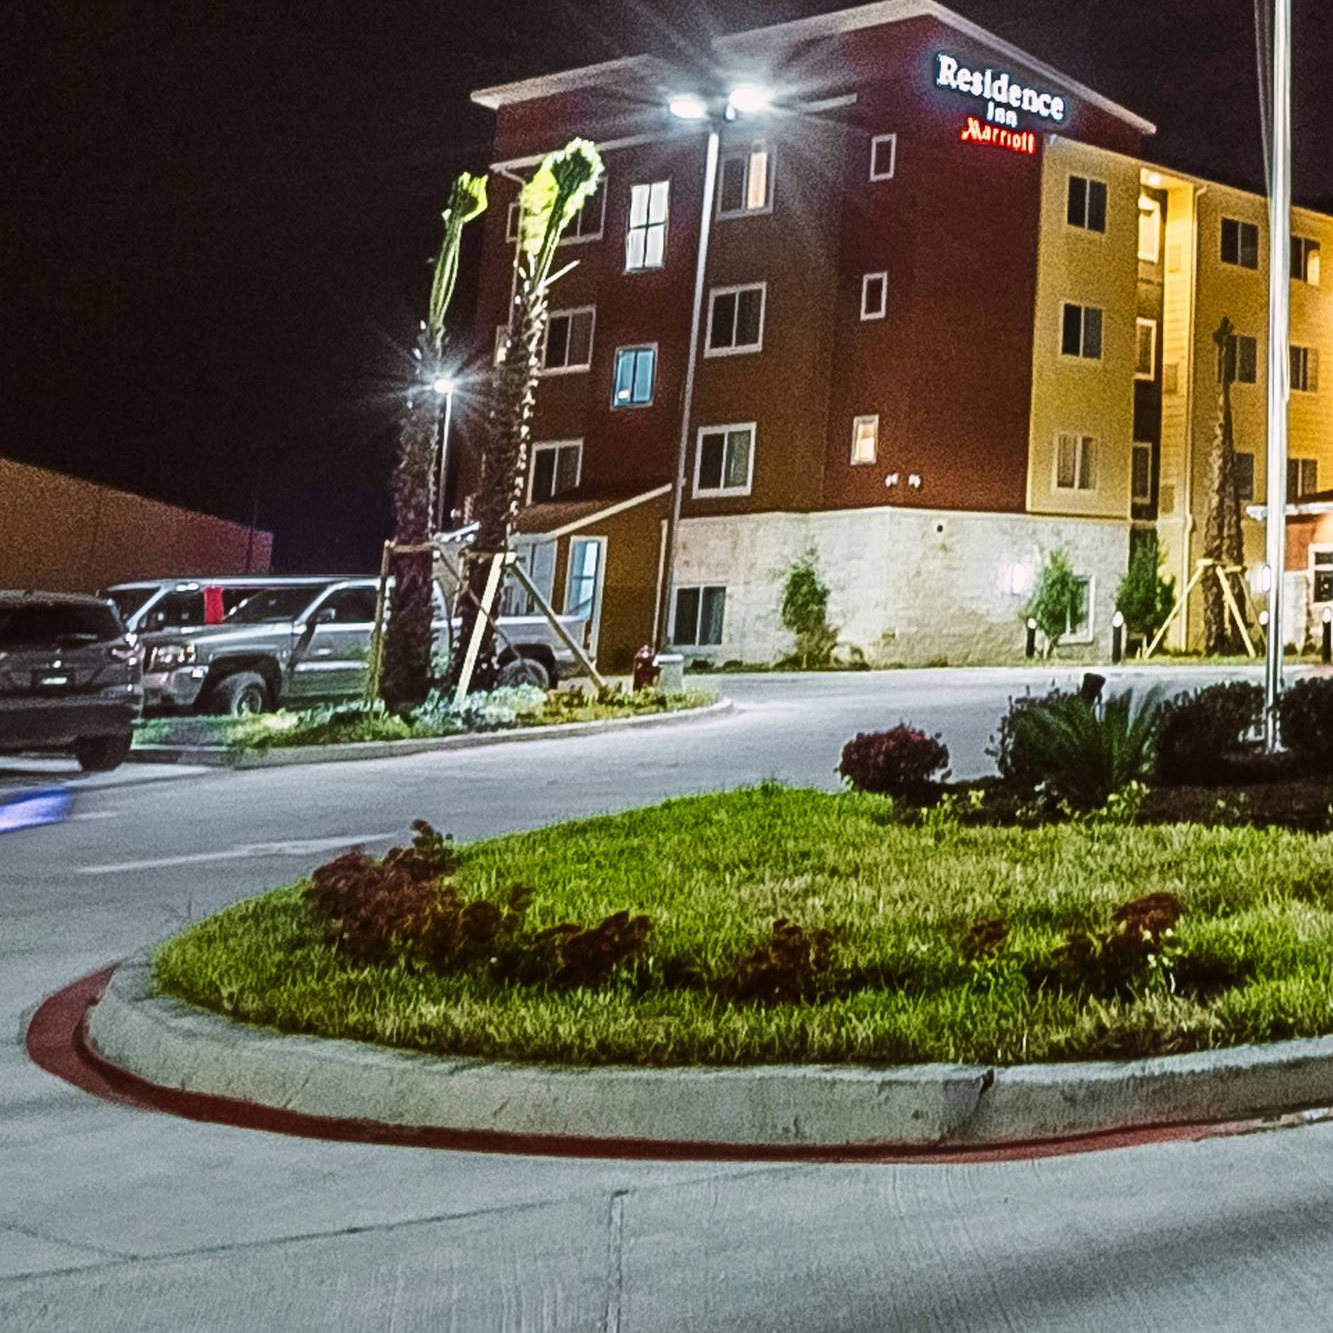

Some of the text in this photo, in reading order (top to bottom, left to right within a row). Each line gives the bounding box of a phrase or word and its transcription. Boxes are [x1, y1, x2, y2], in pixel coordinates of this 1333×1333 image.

[936, 53, 1065, 121] Residence
[986, 101, 1018, 128] Inn
[961, 117, 1035, 154] Marriott
